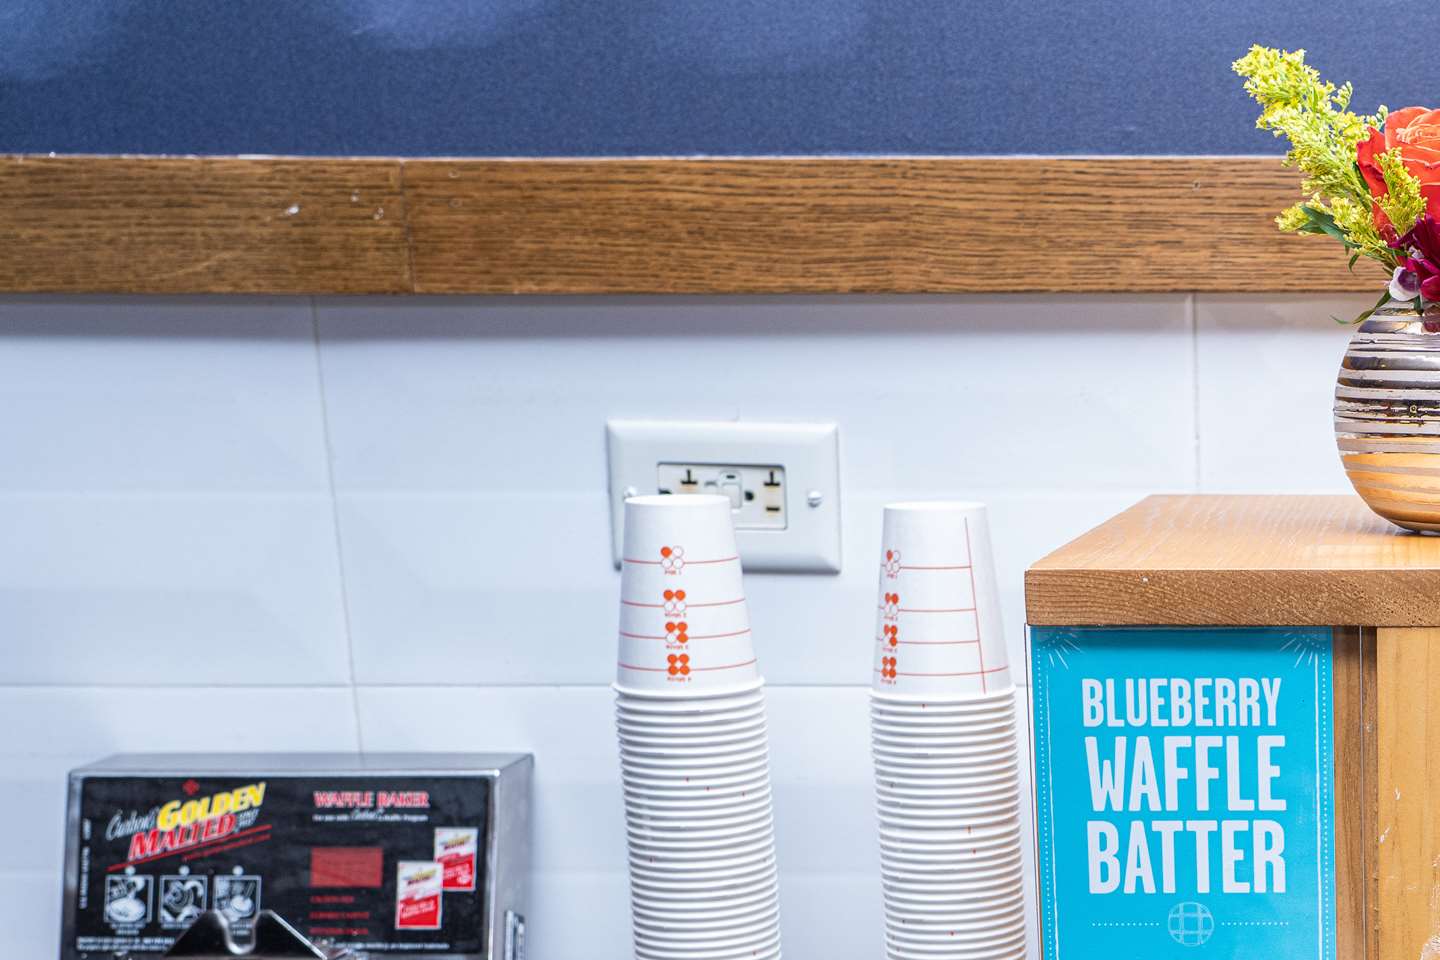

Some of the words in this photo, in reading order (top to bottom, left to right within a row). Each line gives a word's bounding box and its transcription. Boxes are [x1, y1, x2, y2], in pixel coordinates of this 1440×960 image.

[1081, 678, 1282, 727] BLUEBERRY
[1085, 735, 1287, 811] WAFFLE
[155, 781, 266, 831] GOLDEN
[313, 791, 374, 807] WAFFLE
[377, 791, 430, 808] BAKER
[127, 814, 237, 862] MALTED
[1087, 820, 1286, 894] BATTER
